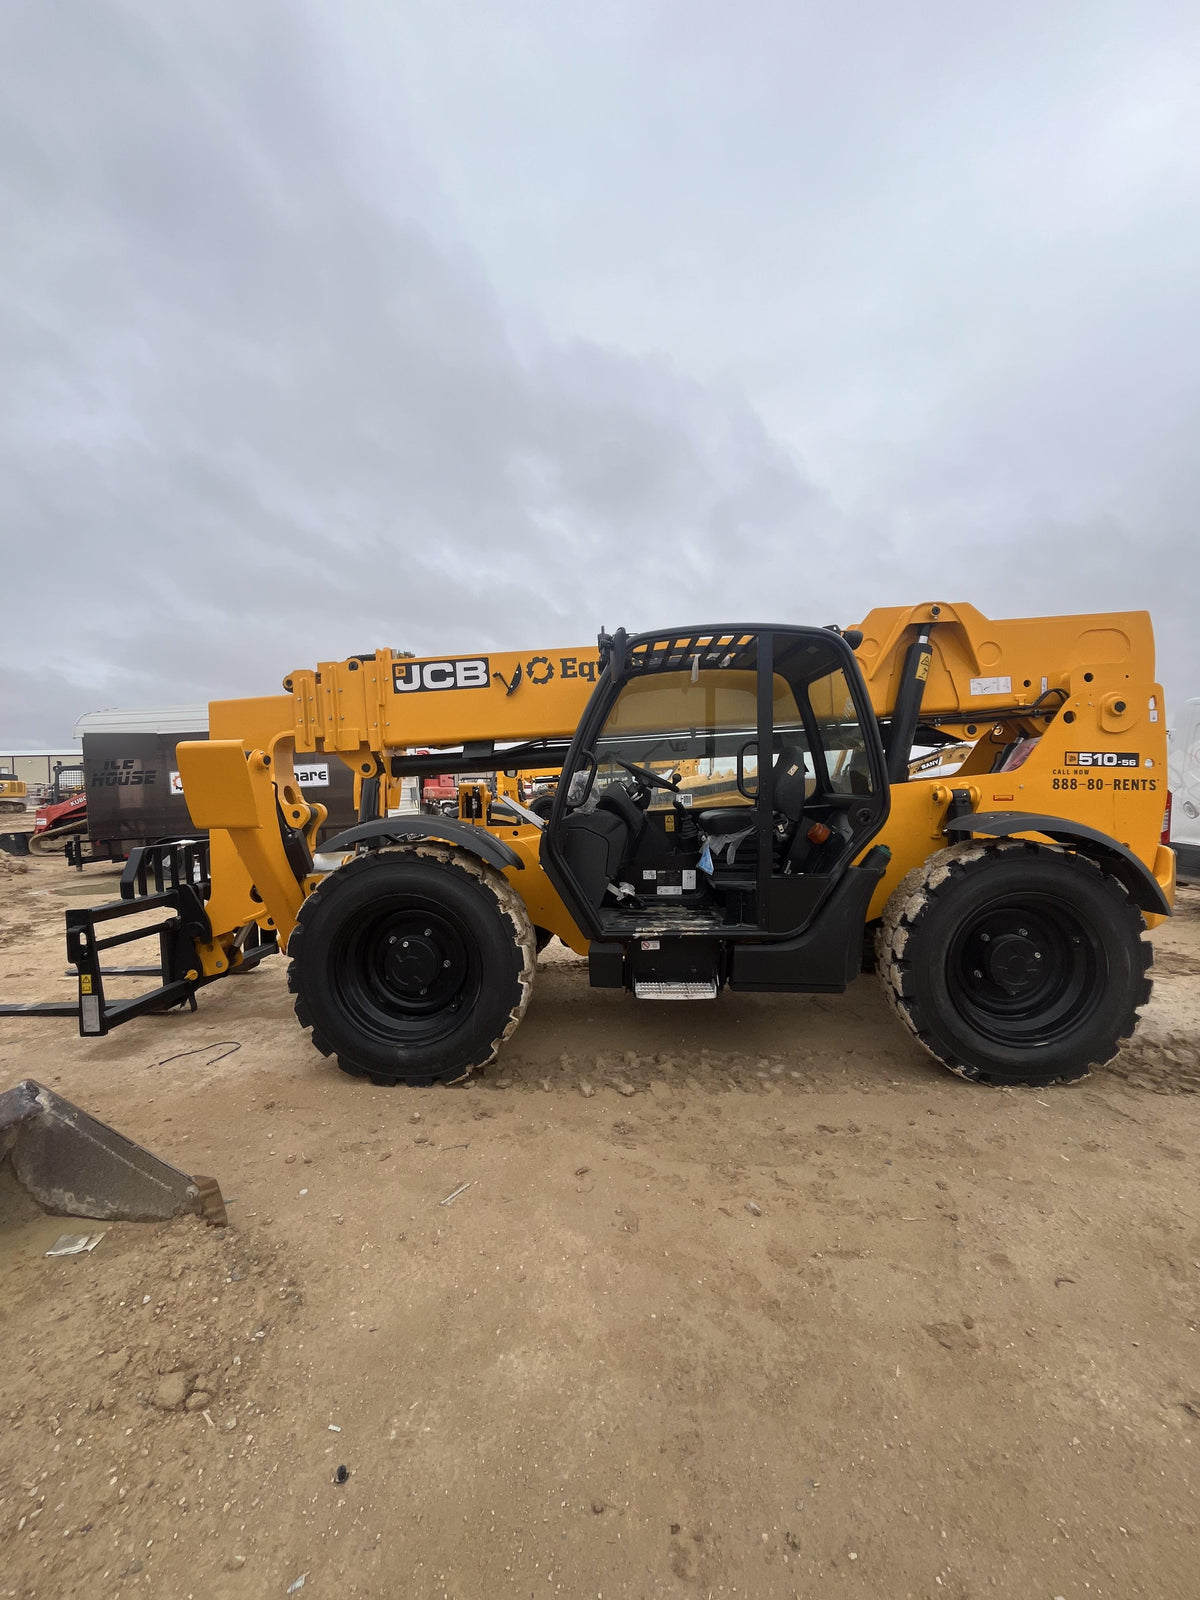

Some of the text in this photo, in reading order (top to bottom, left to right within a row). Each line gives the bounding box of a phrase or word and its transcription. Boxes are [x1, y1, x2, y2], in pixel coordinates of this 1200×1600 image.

[396, 660, 488, 691] JCB
[560, 657, 600, 682] Eq
[1078, 753, 1137, 766] 510-56
[91, 770, 157, 787] HOUSE
[1052, 778, 1157, 791] 888-80-RENTS
